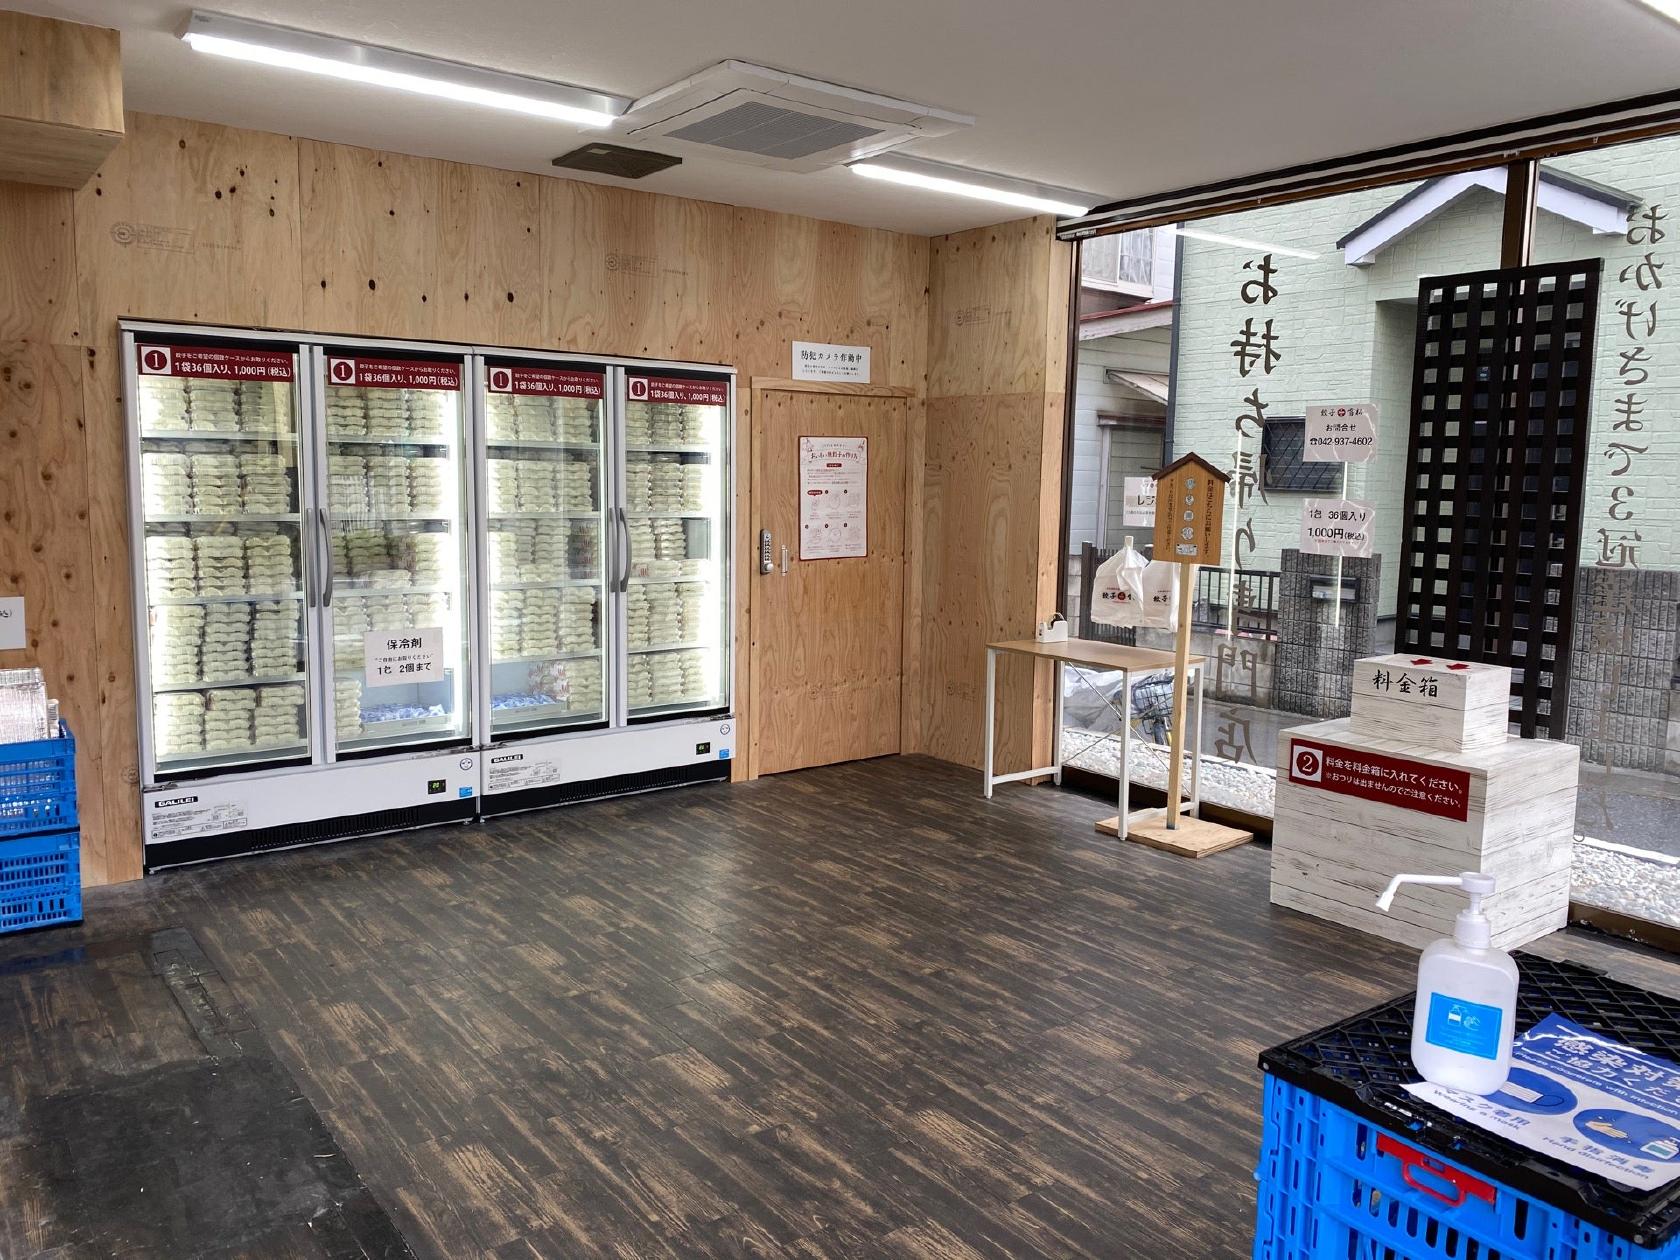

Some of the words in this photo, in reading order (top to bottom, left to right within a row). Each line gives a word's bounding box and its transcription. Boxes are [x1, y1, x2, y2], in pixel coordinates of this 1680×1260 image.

[800, 350, 863, 364] 防犯カメラ作動中
[1326, 423, 1356, 432] お問合せ
[1328, 510, 1366, 521] 36個入り
[387, 637, 422, 650] 保冷剤
[399, 662, 432, 673] 2個まで
[1372, 669, 1438, 697] 料金箱
[1326, 756, 1463, 795] 料金を料金箱に入れてください。
[158, 797, 195, 807] GALILEI
